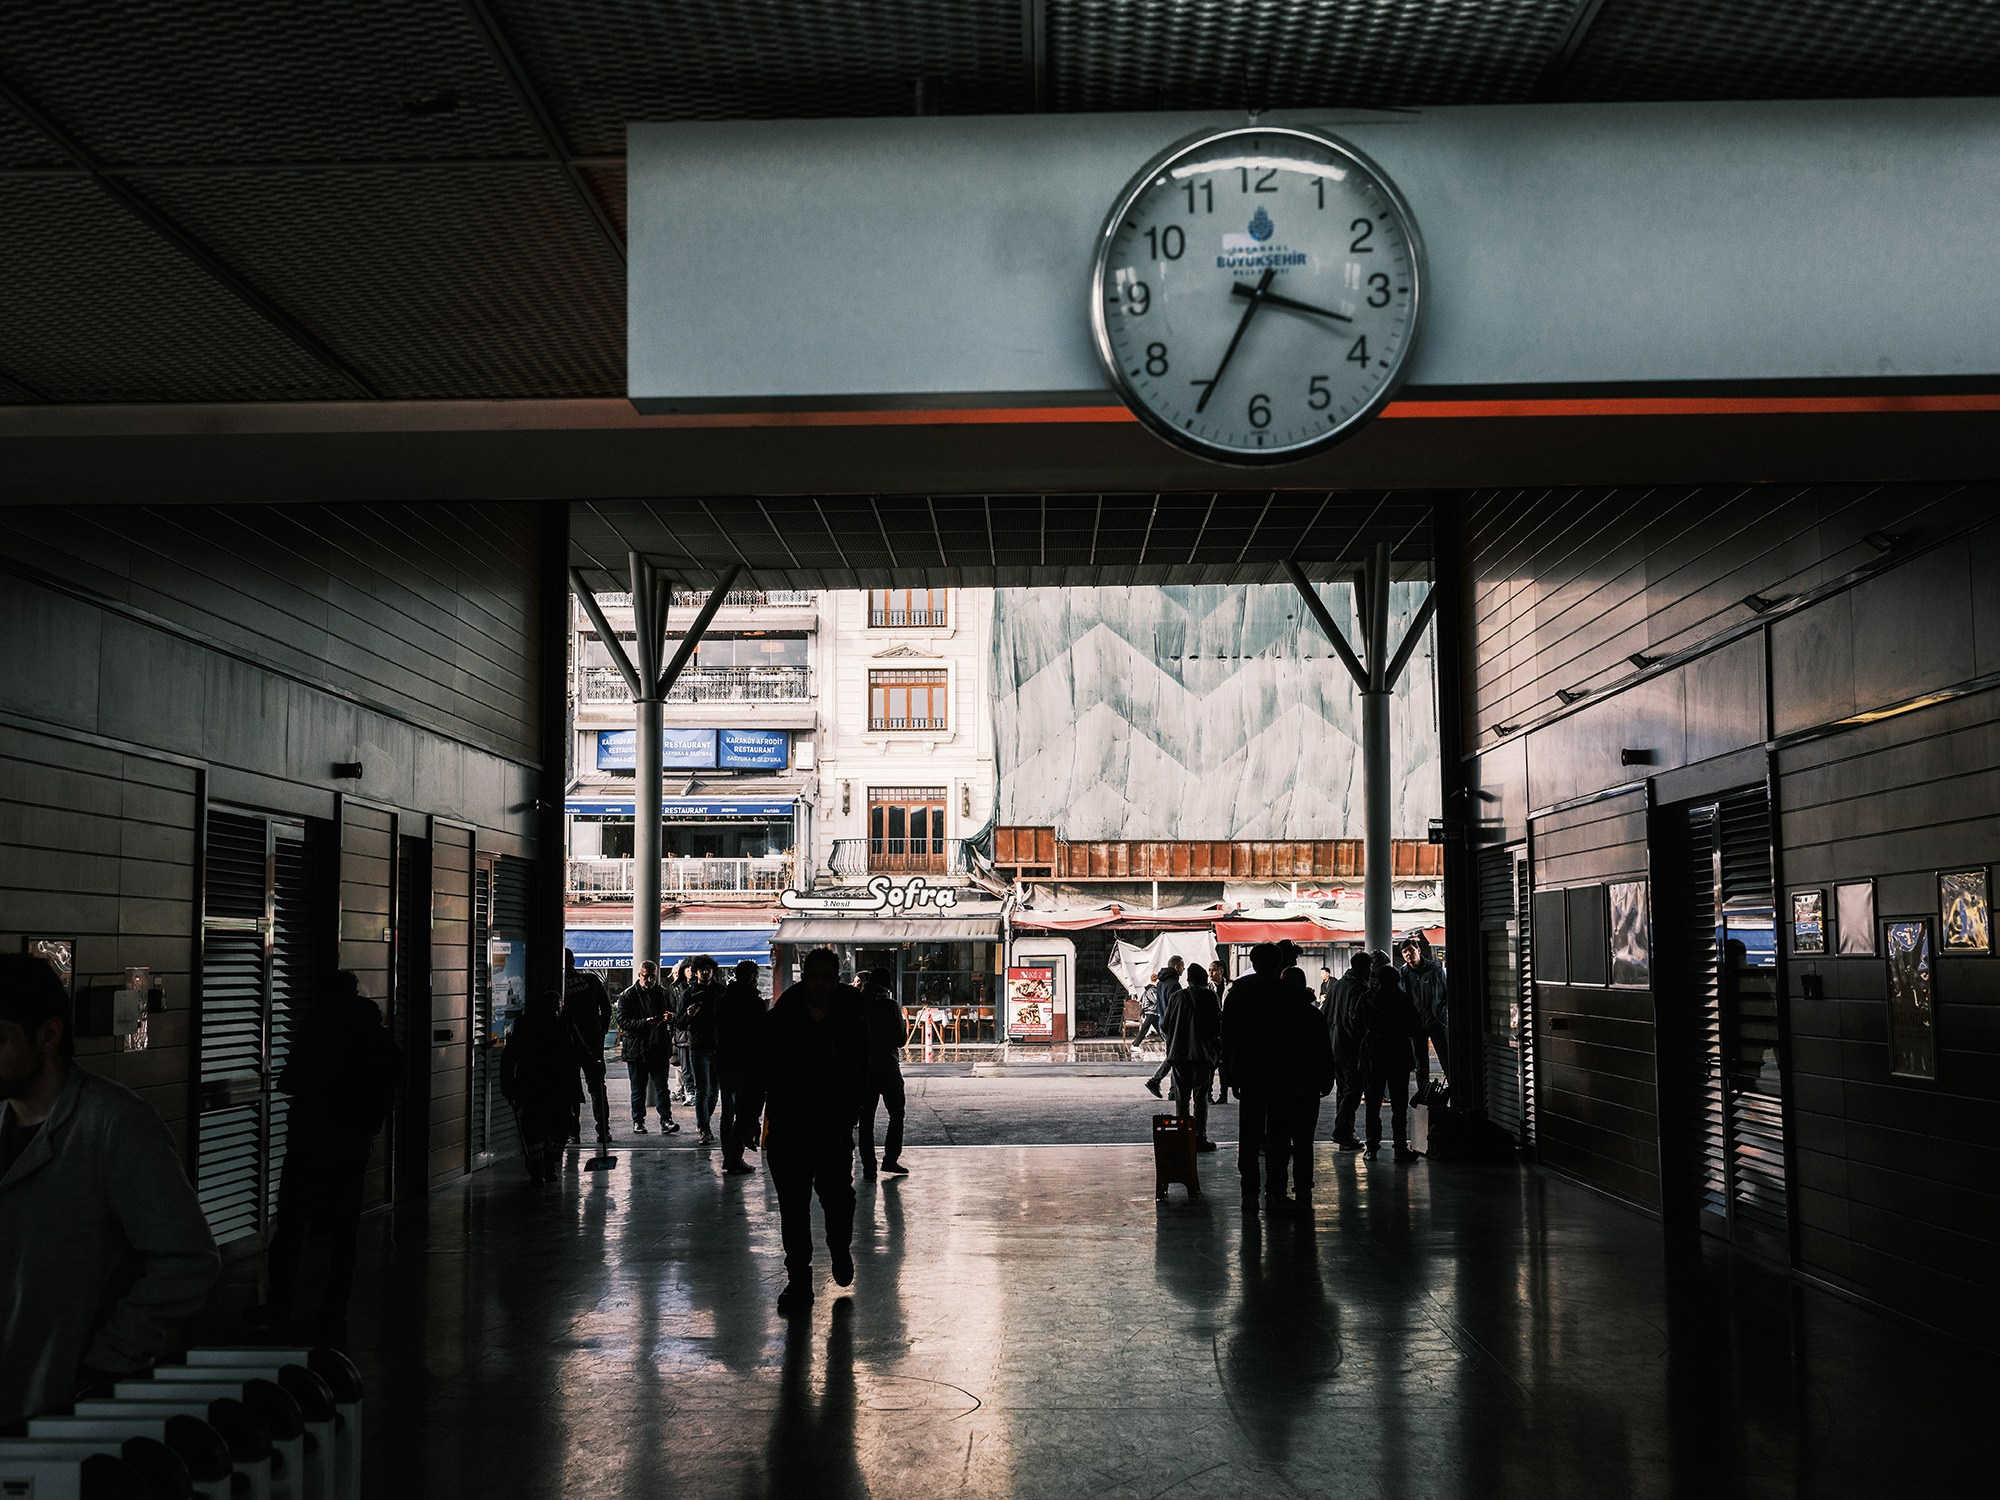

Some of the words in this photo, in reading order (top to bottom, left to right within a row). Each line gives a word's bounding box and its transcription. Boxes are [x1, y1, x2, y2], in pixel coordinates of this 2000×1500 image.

[1181, 178, 1214, 214] 11
[1238, 165, 1279, 194] 12
[1311, 175, 1324, 210] 1
[1144, 224, 1187, 261] 10
[1349, 217, 1375, 254] 2
[1127, 280, 1151, 316] 9
[1366, 272, 1392, 308] 3
[1145, 342, 1169, 377] 8
[1346, 334, 1371, 369] 4
[1190, 379, 1217, 414] 7
[1307, 374, 1331, 410] 5
[1247, 393, 1272, 429] 6
[664, 741, 711, 749] RESTAURANT
[726, 736, 756, 745] KARAKÖY
[756, 736, 783, 745] AFRODİT
[734, 745, 775, 754] RESTAURANT
[867, 875, 957, 910] Sofra
[583, 957, 614, 968] AFRODİT
